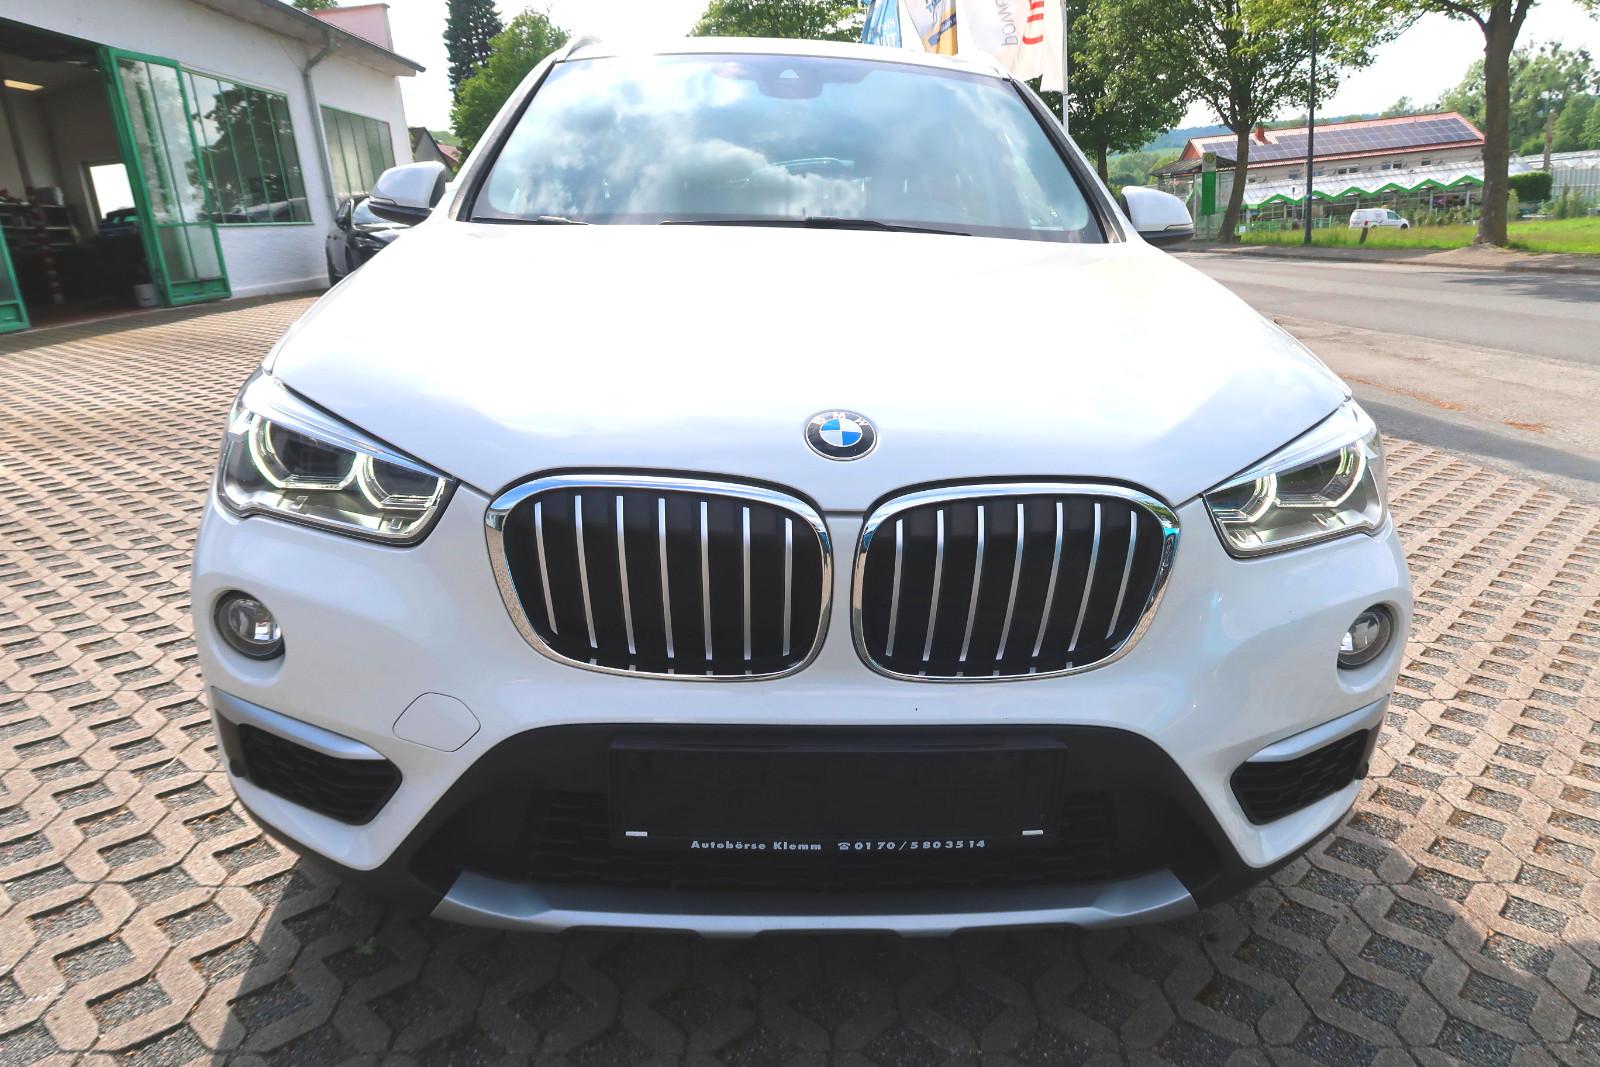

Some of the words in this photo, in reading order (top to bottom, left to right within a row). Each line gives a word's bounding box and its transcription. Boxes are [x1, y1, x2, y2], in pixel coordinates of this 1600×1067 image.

[810, 411, 871, 427] BMW
[690, 840, 767, 850] Autobörse
[773, 841, 822, 851] Klemm
